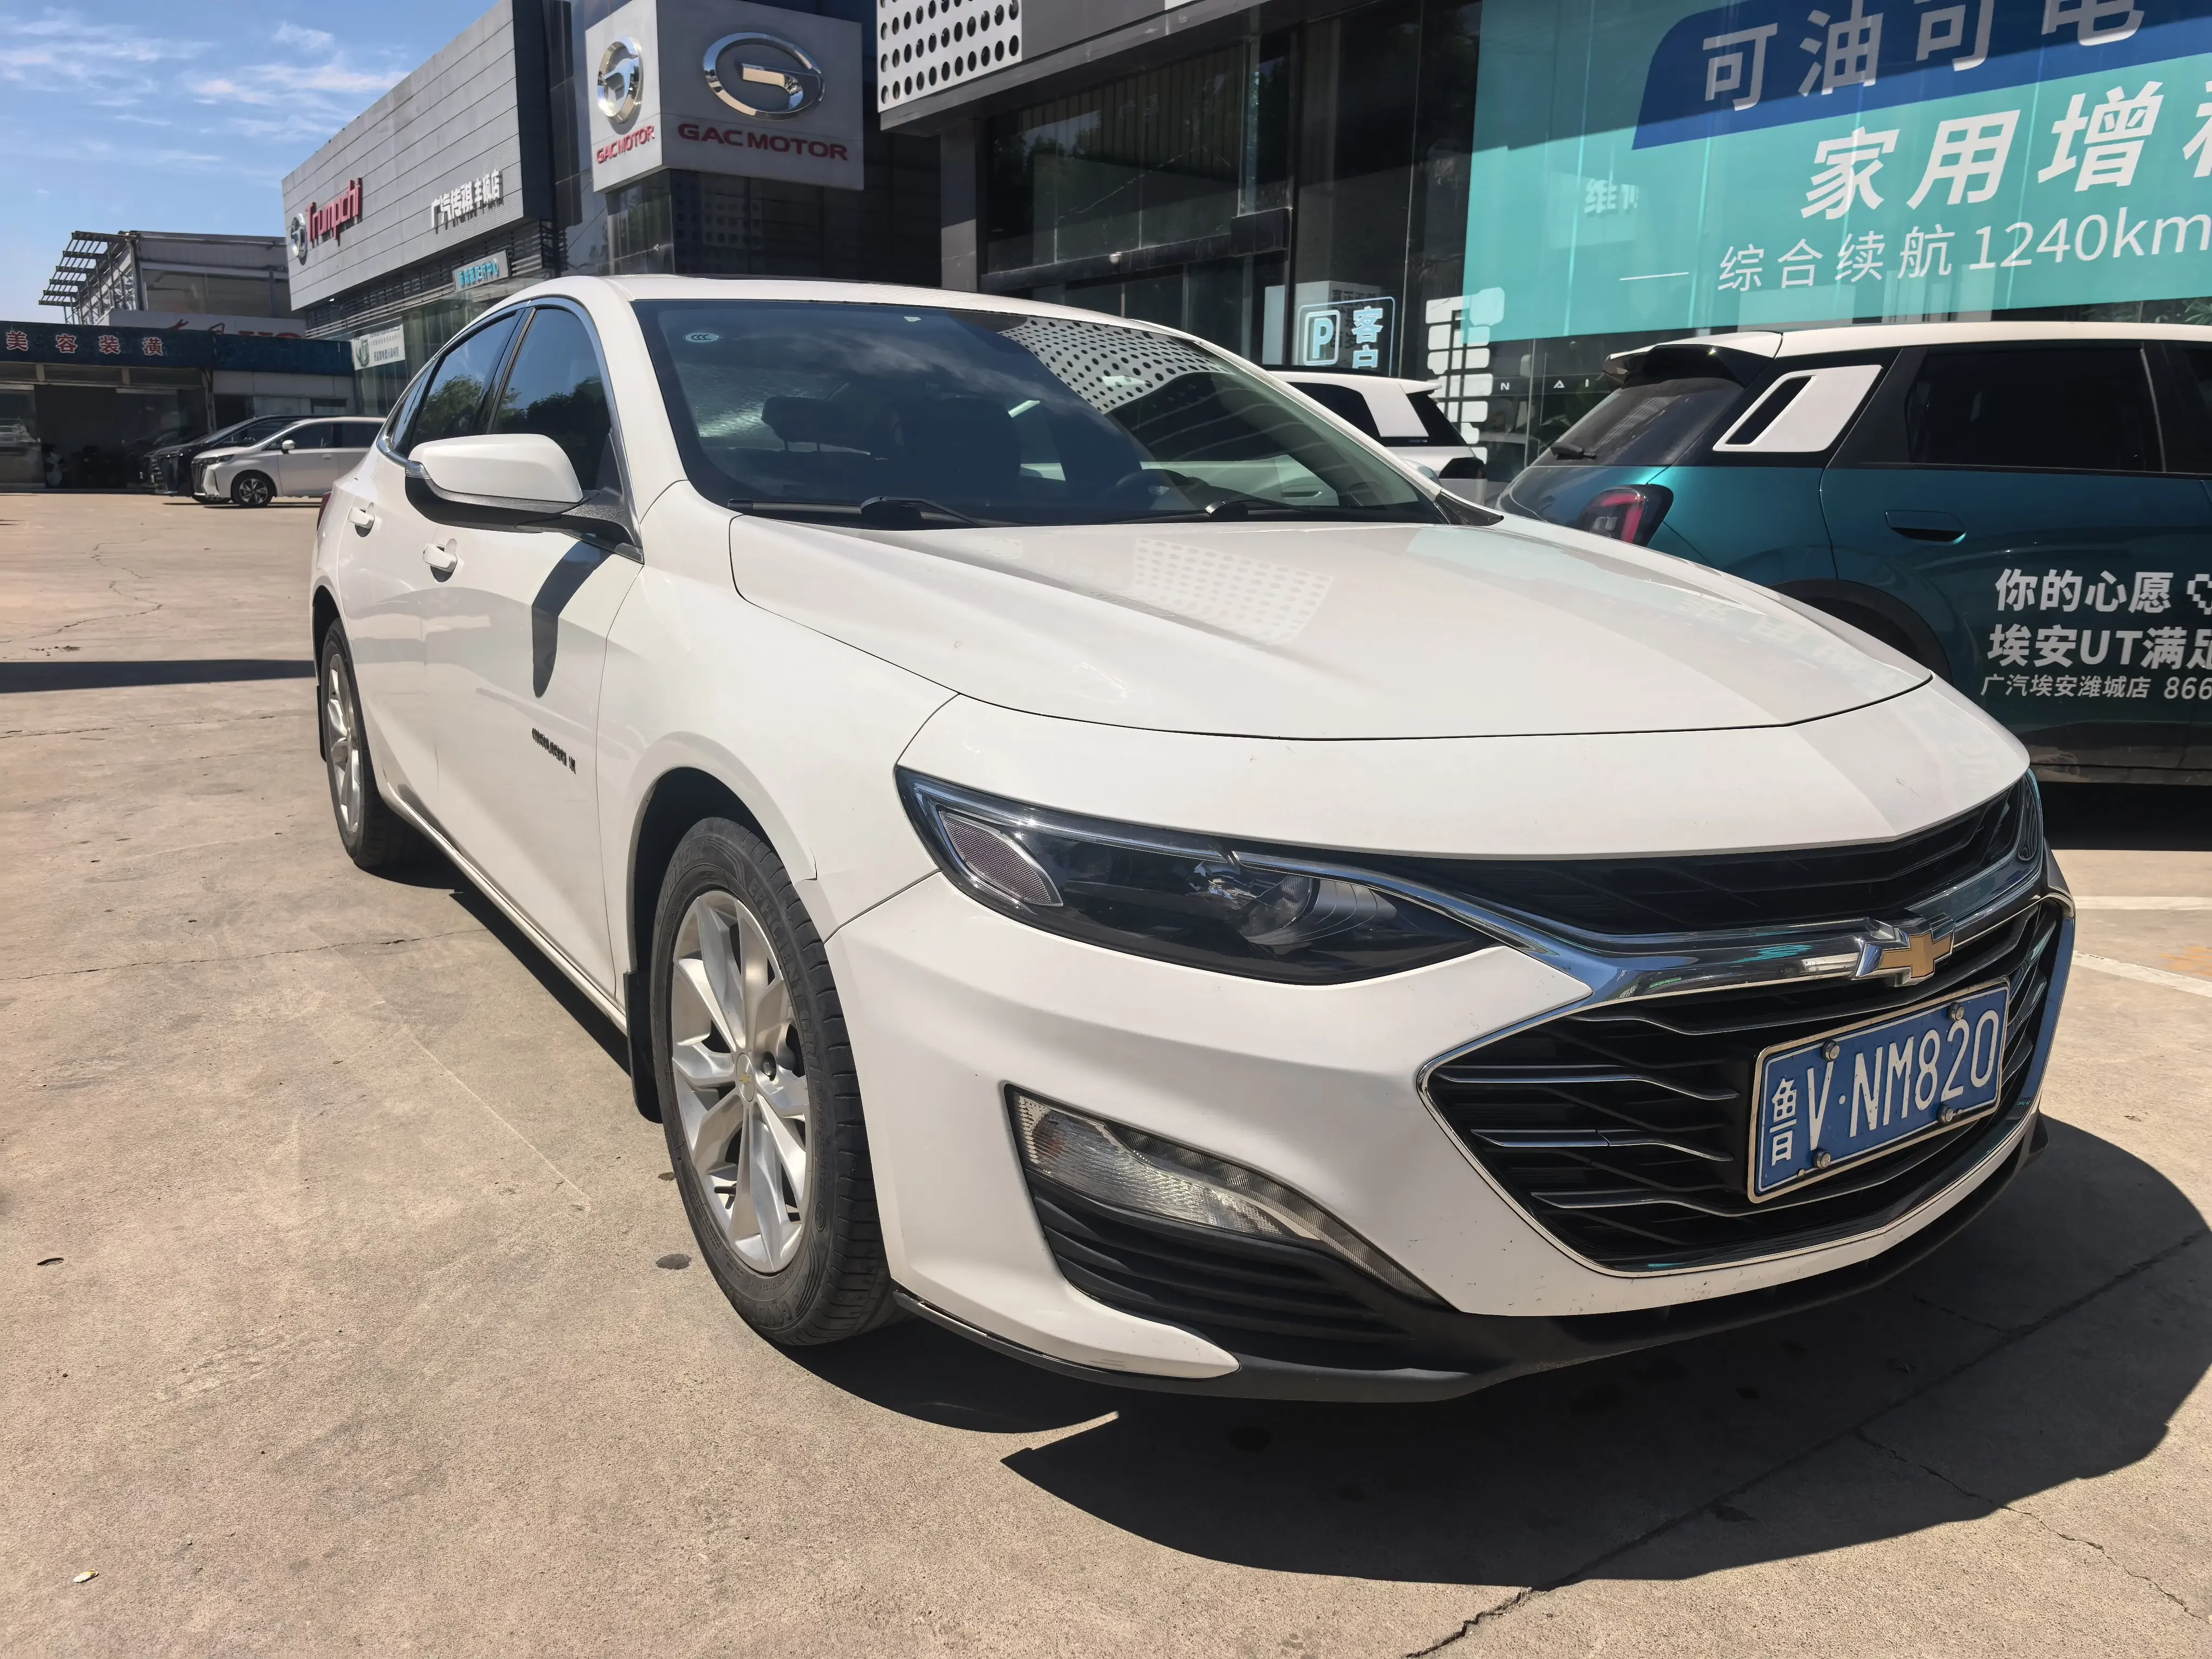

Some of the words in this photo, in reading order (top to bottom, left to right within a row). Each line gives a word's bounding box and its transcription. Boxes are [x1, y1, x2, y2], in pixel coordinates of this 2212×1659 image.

[597, 141, 618, 164] GAC
[618, 125, 655, 154] MOTOR
[678, 123, 743, 147] GAC
[747, 134, 848, 161] MOTOR
[305, 177, 363, 243] Trumpchi
[6, 331, 164, 356] 美容装潢
[1312, 318, 1334, 359] P
[1995, 568, 2174, 613] 你的心愿
[1987, 624, 2212, 670] 埃安UT满足
[1980, 673, 2152, 698] 广汽埃安潍城店
